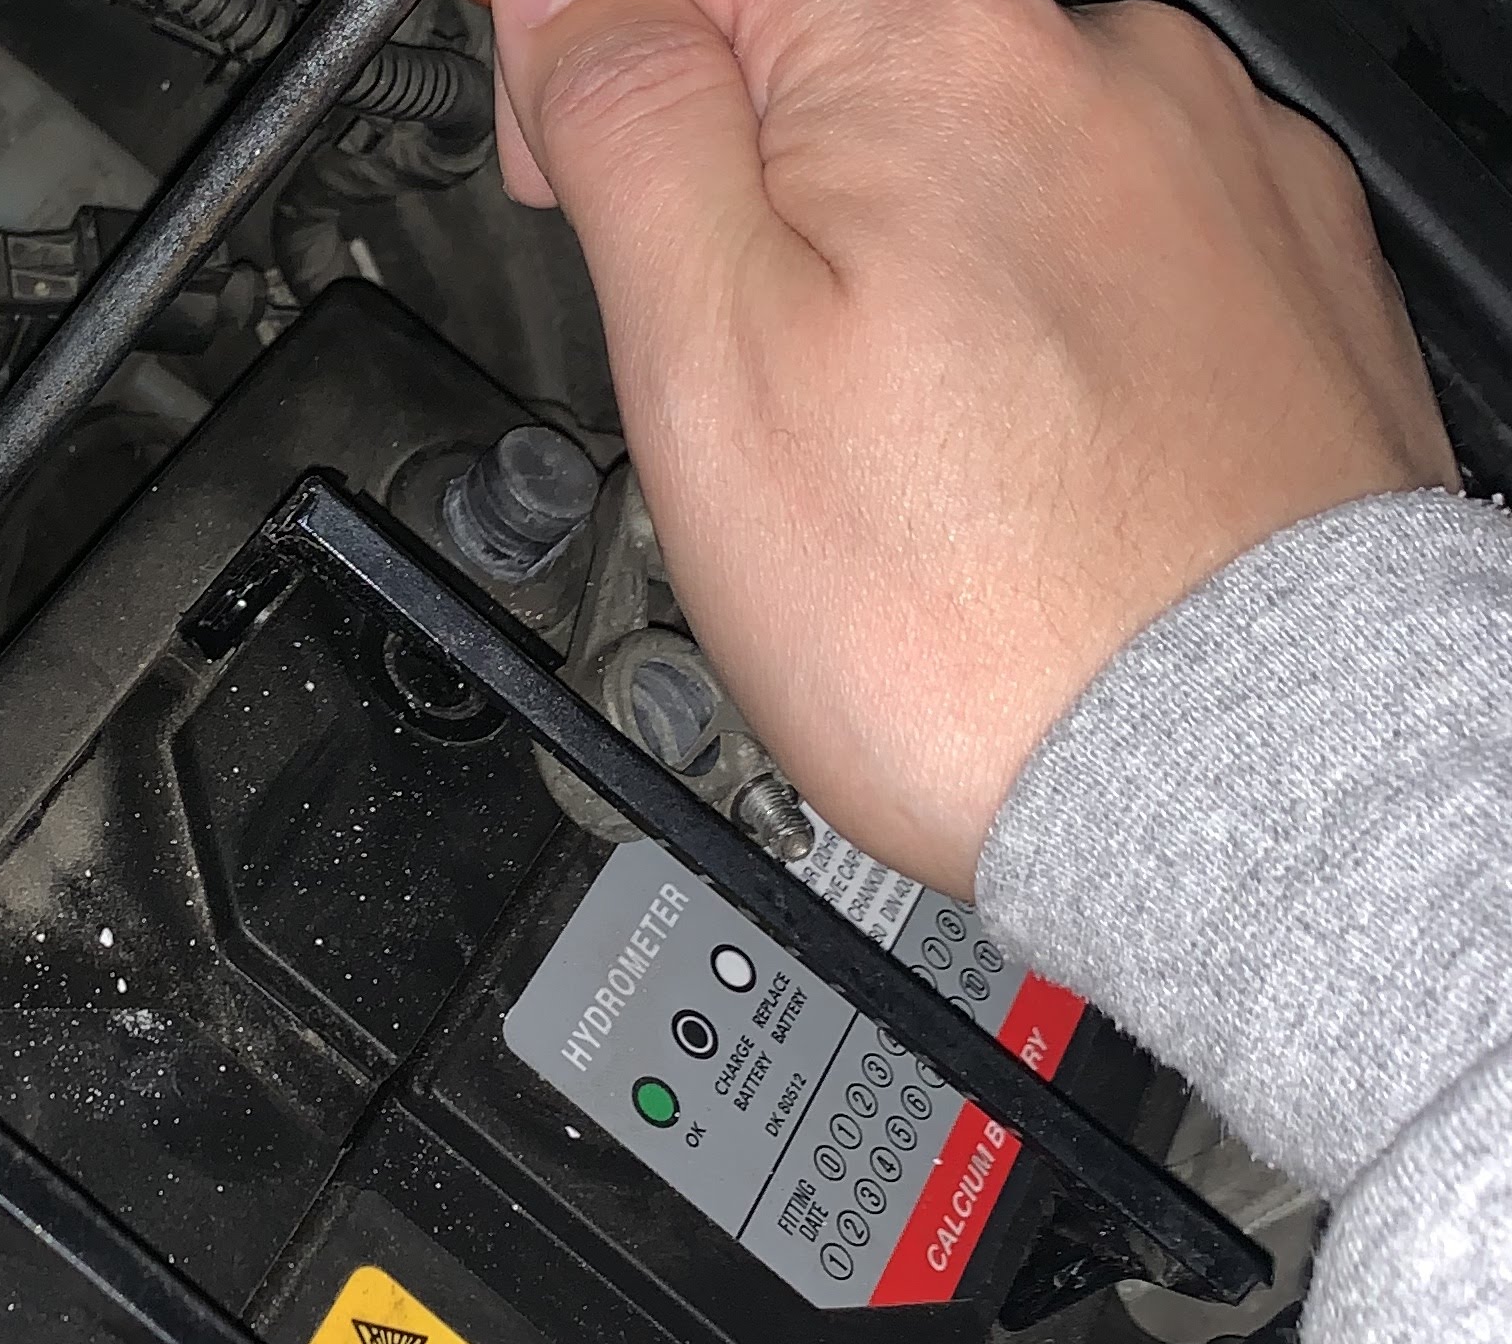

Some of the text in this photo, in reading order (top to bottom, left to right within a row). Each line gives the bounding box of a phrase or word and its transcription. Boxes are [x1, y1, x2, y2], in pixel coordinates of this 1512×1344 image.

[558, 878, 692, 1075] HYDROMETER
[750, 969, 792, 1031] REPLACE
[769, 984, 810, 1047] BATTERY
[711, 1032, 757, 1100] CHARGE
[732, 1049, 775, 1114] BATTERY
[682, 1118, 708, 1152] OK
[763, 1069, 808, 1140] DK 80512
[776, 1175, 817, 1238] FITTING
[798, 1199, 830, 1245] DATE
[922, 1141, 996, 1276] CALCIUM
